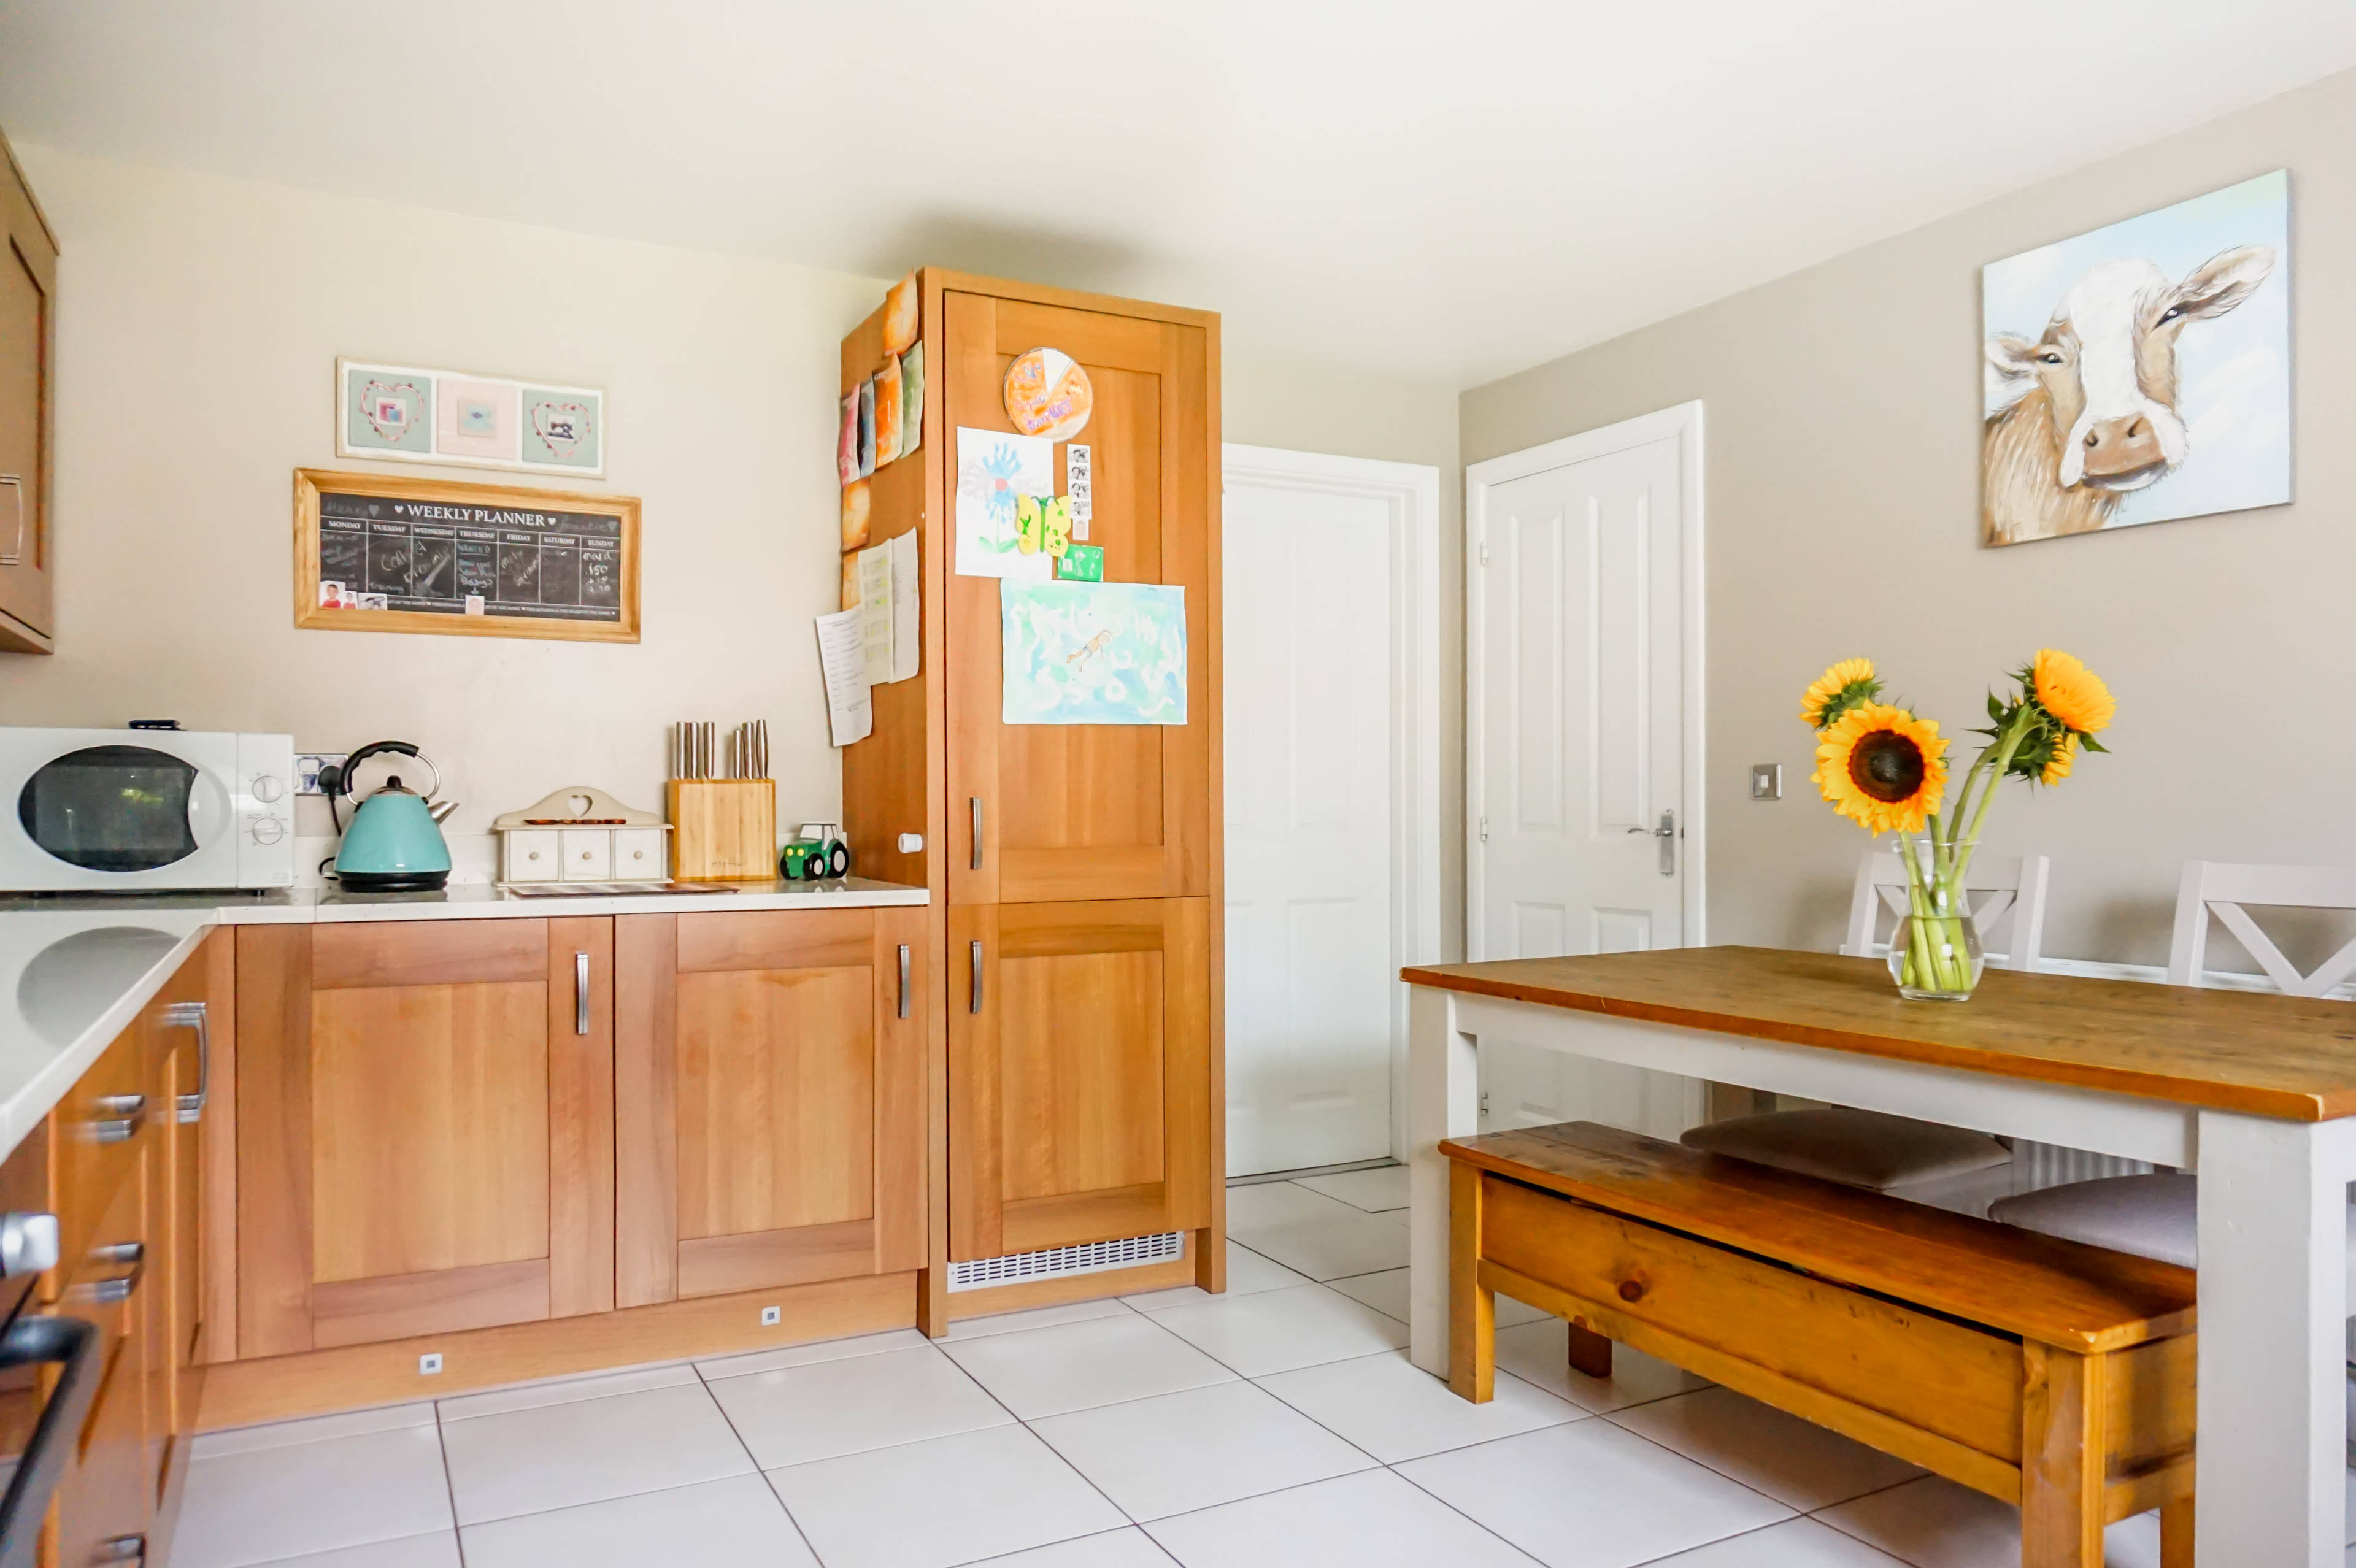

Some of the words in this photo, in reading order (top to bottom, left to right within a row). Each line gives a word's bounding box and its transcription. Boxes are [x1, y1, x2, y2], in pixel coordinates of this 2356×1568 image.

[407, 504, 471, 520] WEEKLY
[475, 510, 545, 526] PLANNER
[328, 521, 361, 529] MONDAY
[372, 524, 406, 533] TUESDAY
[414, 526, 455, 536] WEDNESDAY
[459, 530, 495, 540] THURSDAY
[507, 533, 531, 542] FRIDAY
